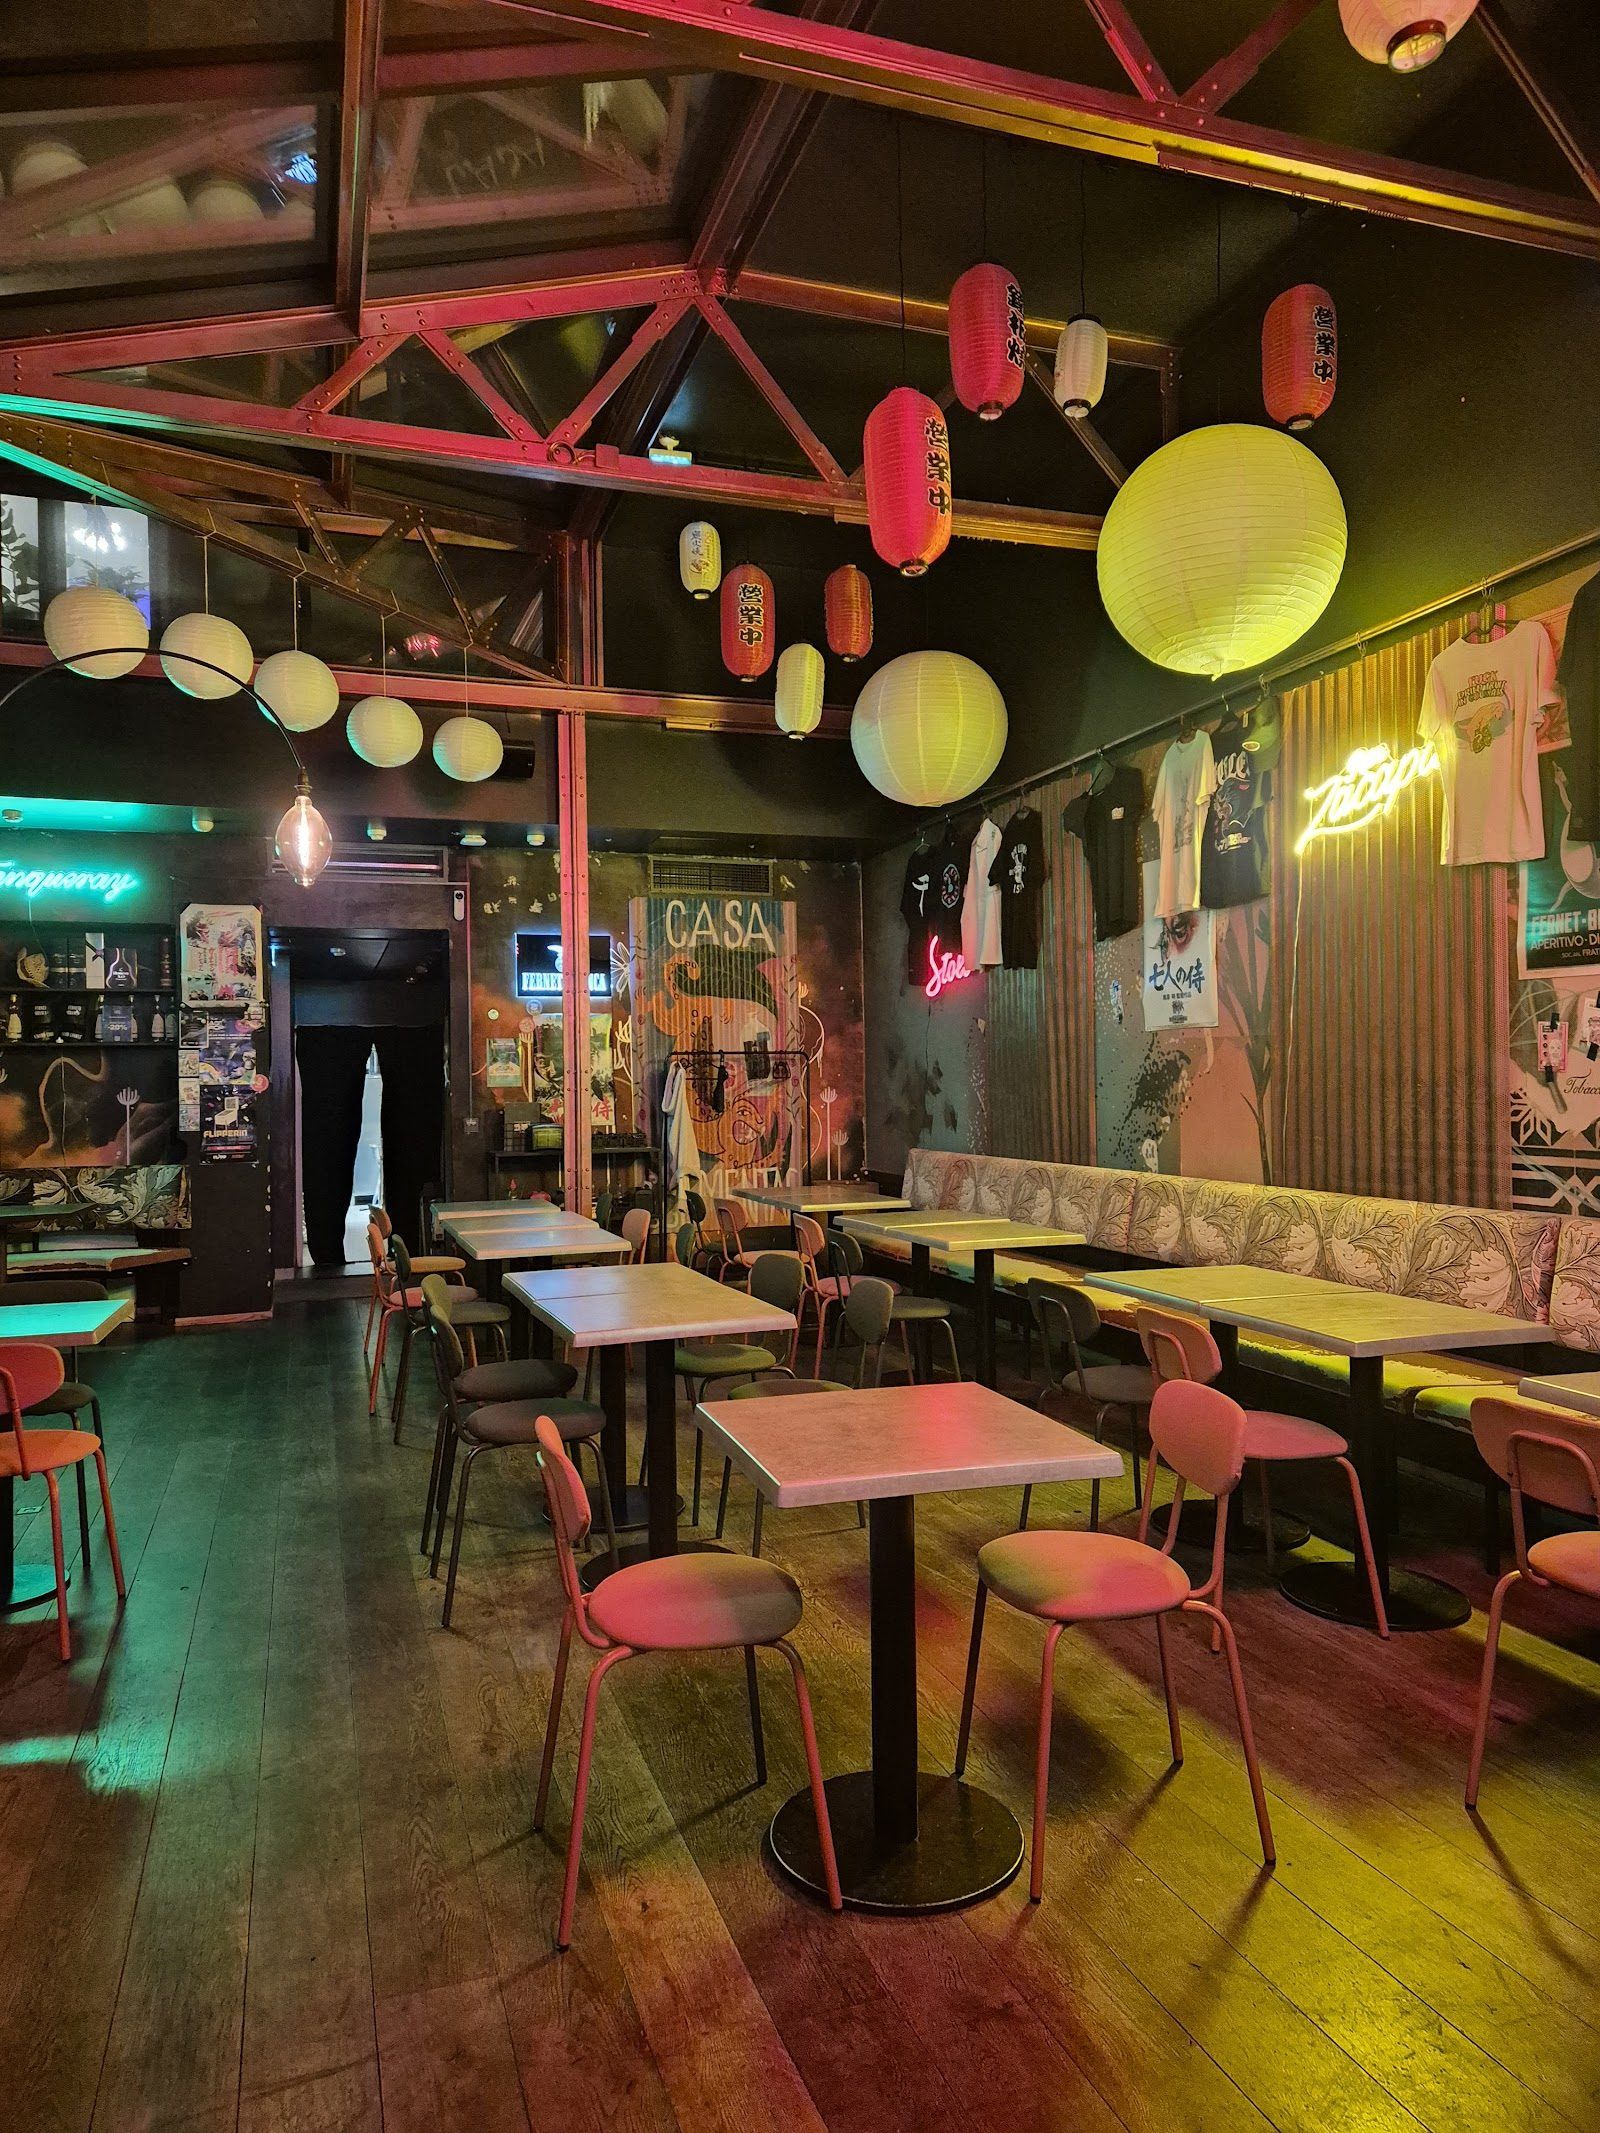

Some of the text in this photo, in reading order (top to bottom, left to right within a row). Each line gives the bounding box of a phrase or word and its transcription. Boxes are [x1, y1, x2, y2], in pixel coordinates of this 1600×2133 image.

[665, 900, 777, 954] CASA
[1149, 957, 1205, 994] 七人の侍
